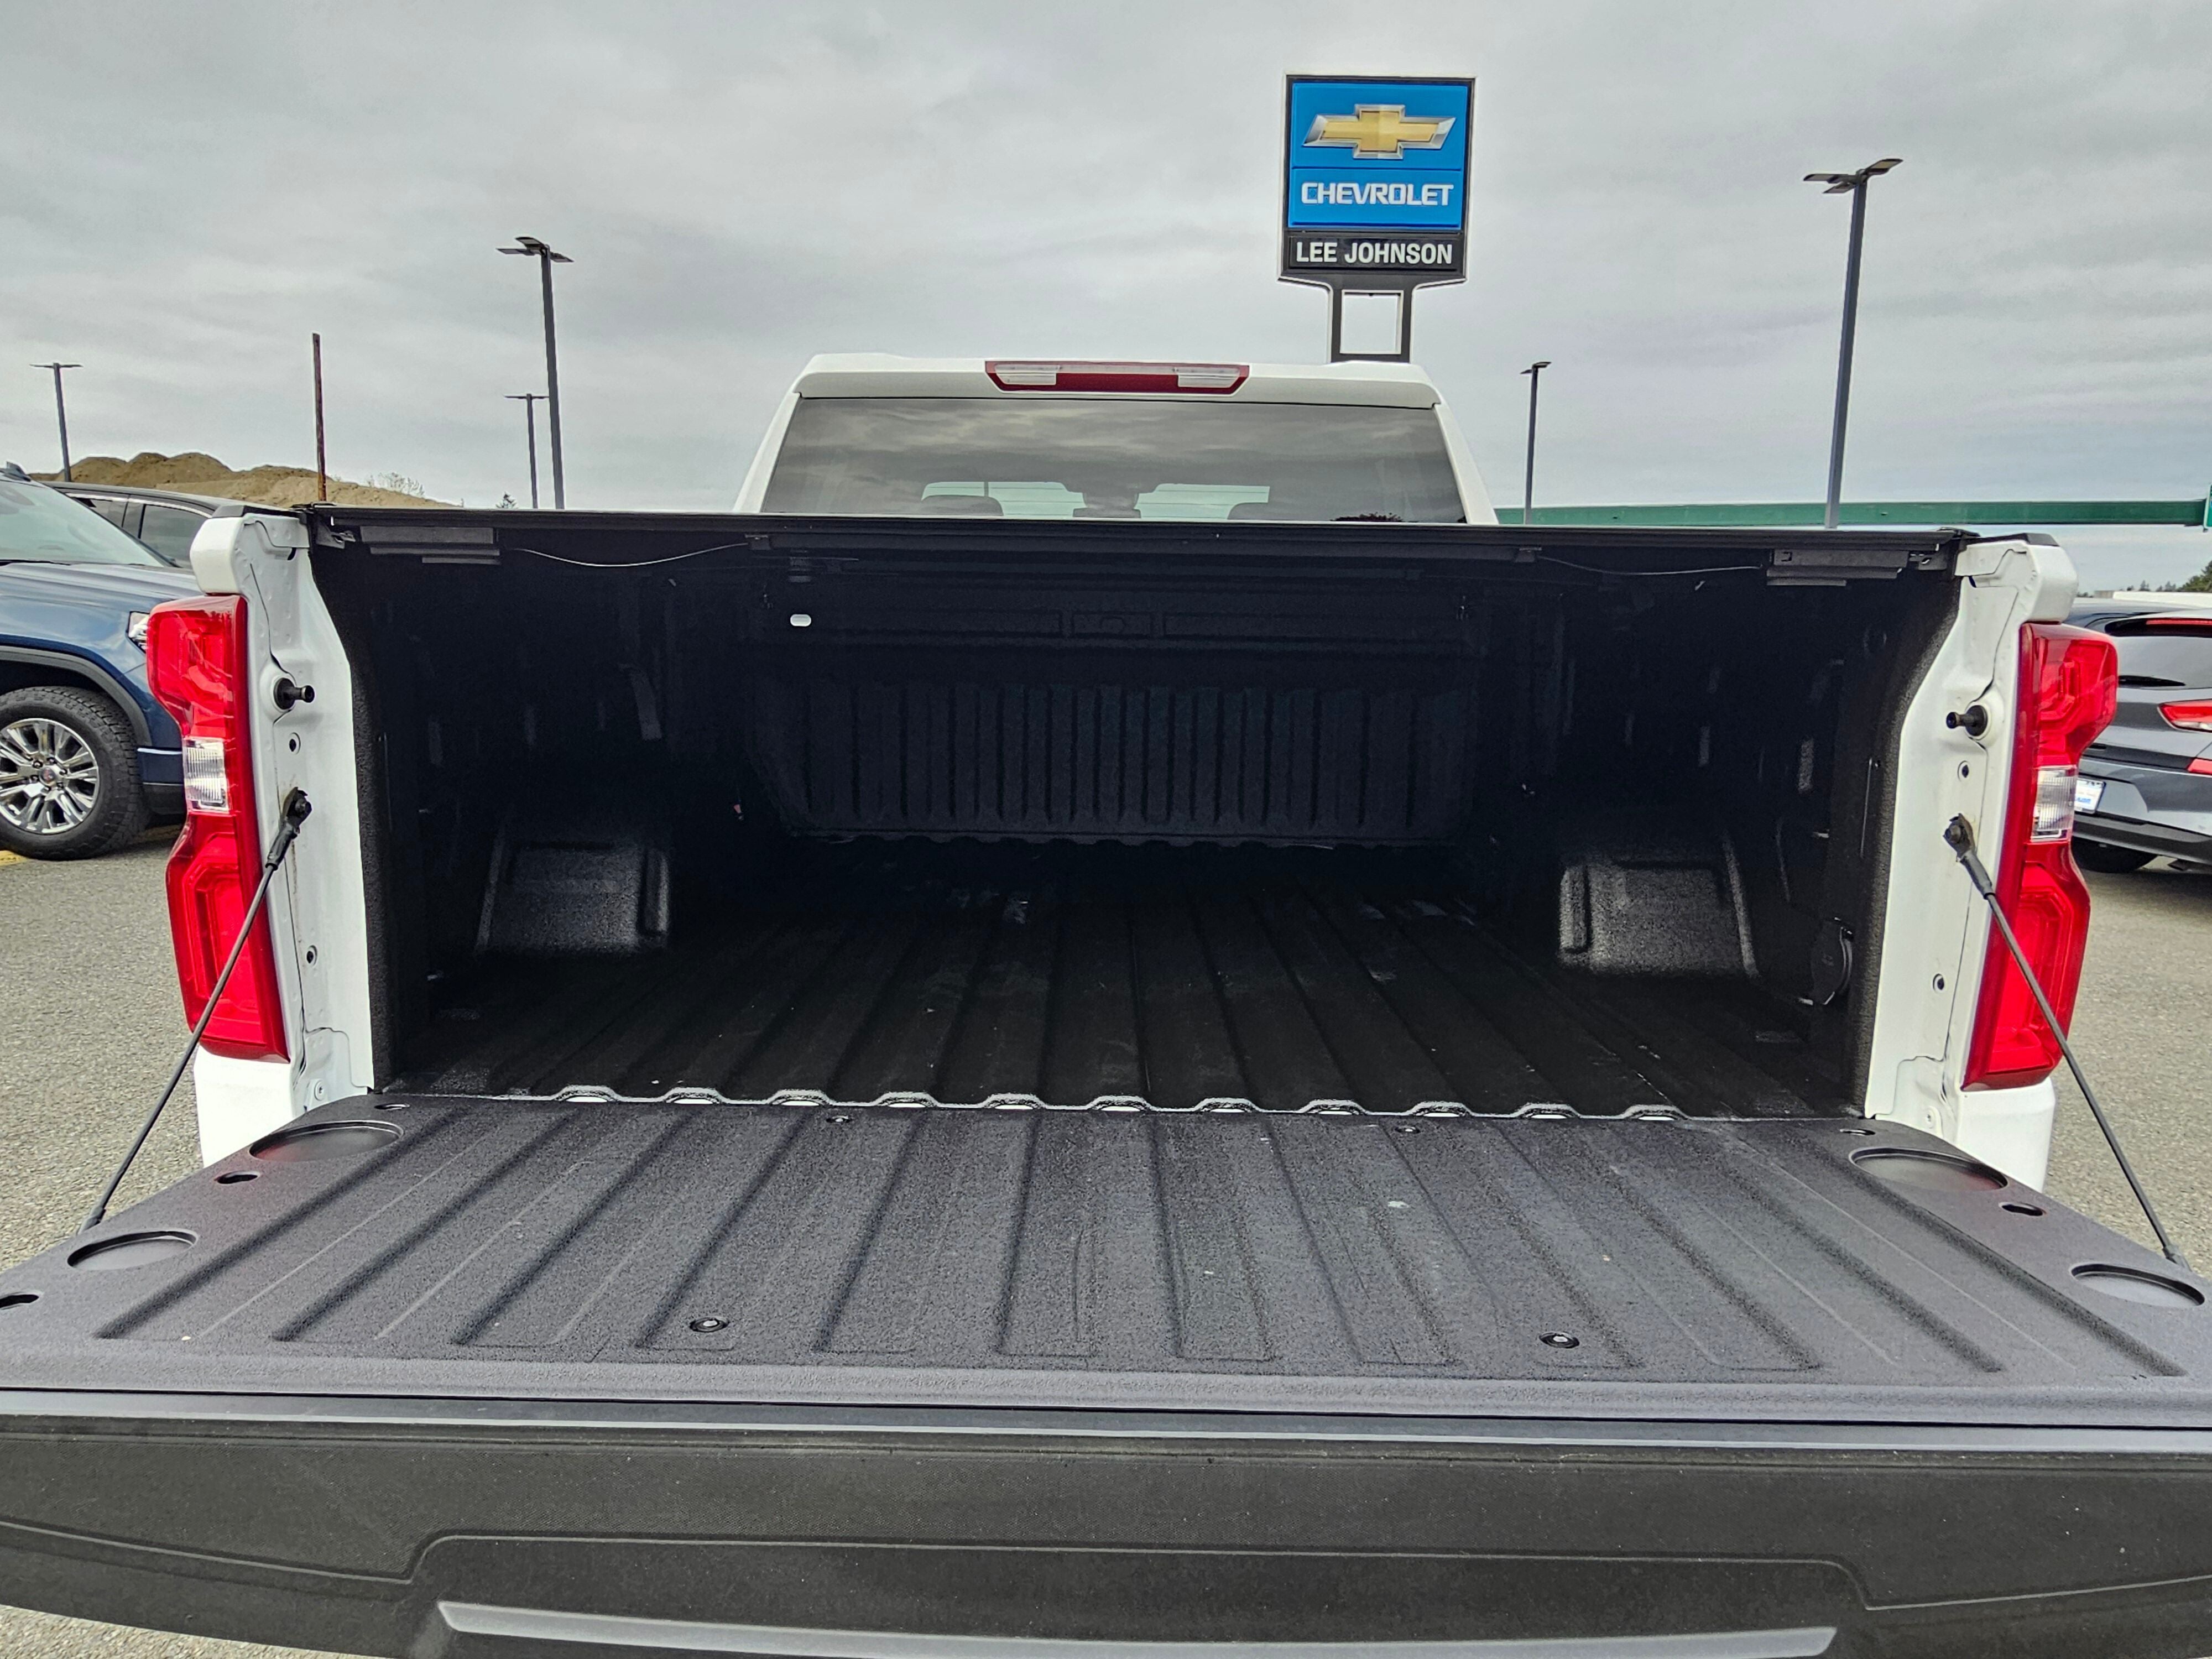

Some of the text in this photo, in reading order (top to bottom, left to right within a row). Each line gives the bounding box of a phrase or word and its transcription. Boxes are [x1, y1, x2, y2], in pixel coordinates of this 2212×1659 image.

[1301, 182, 1454, 206] CHEVROLET
[1296, 242, 1452, 264] LEE JOHNSON
